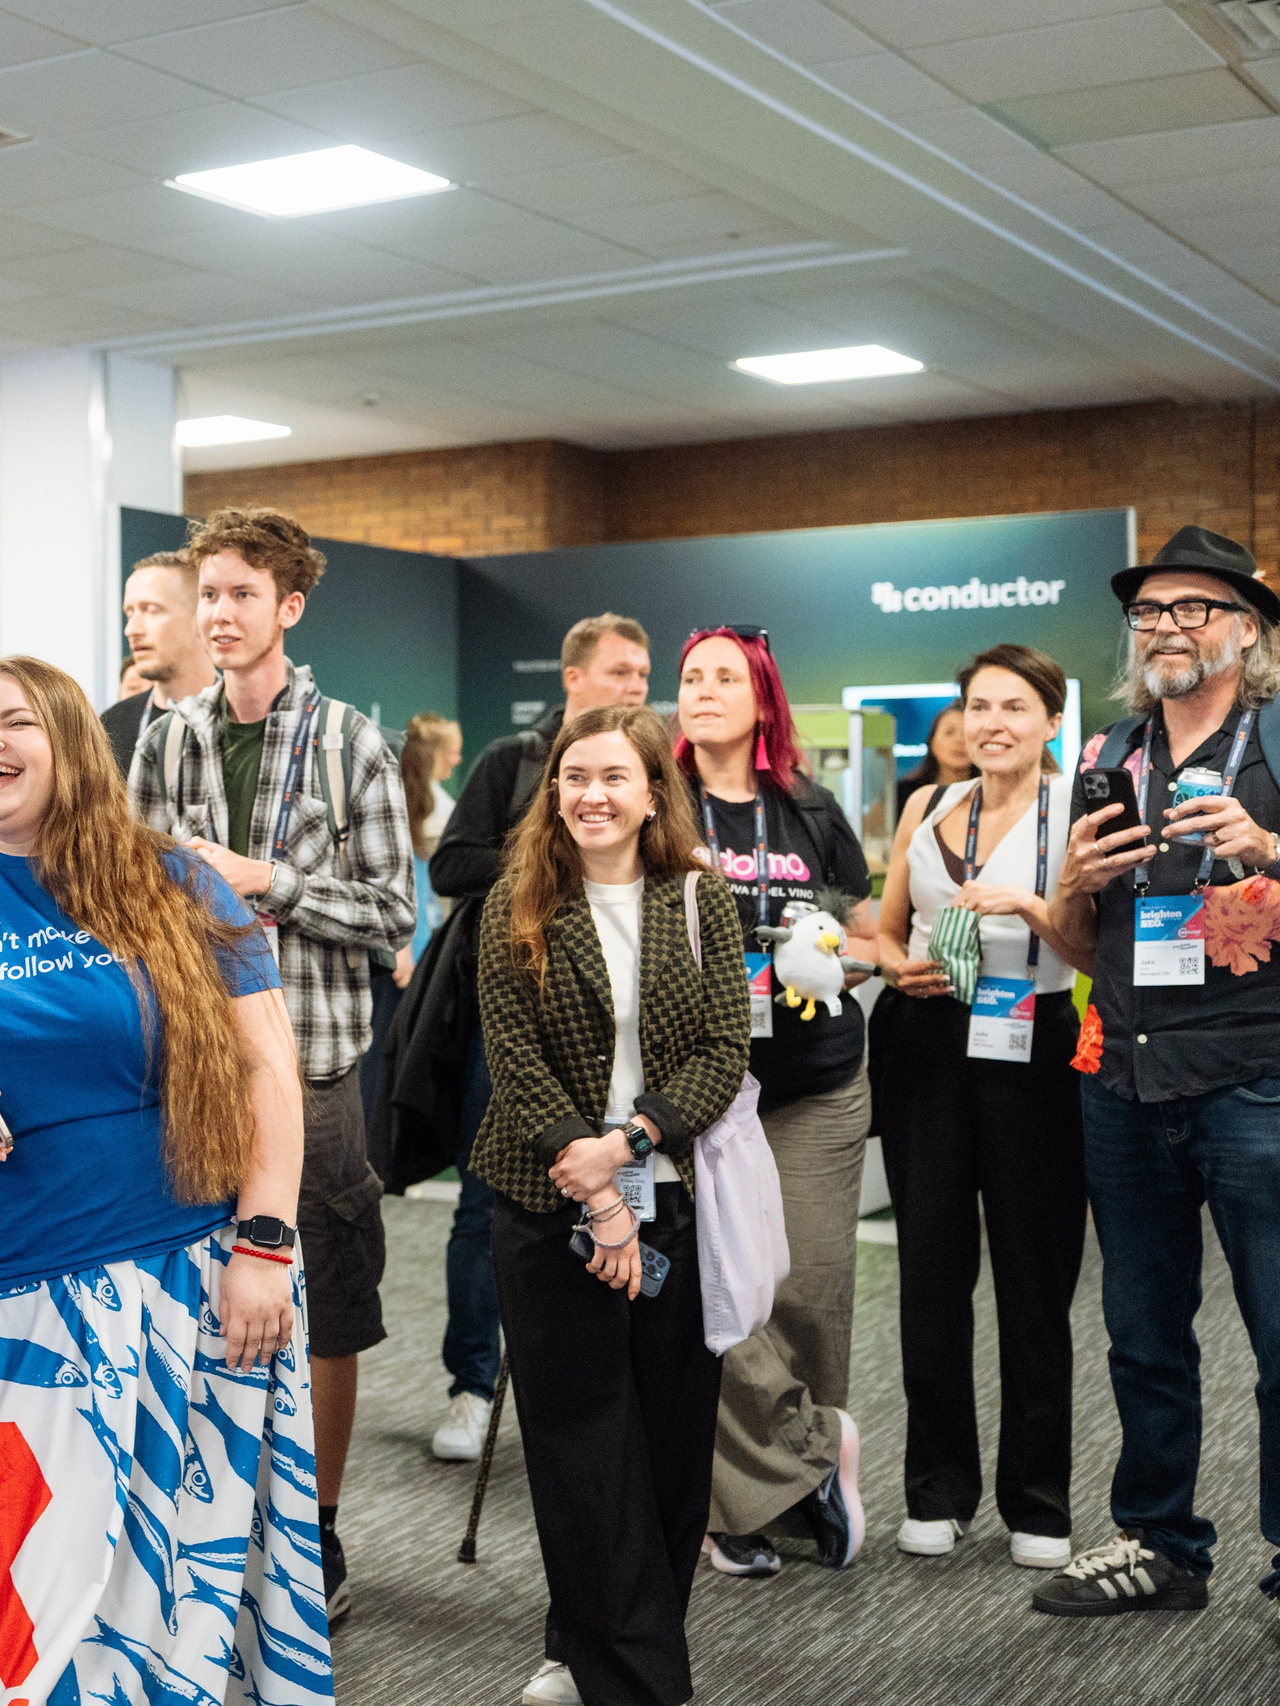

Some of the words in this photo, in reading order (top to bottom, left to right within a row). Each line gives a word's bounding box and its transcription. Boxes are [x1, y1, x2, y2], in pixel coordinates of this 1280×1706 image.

[903, 576, 1066, 612] conductor
[788, 886, 814, 899] VINO
[1140, 909, 1182, 920] brighton
[27, 926, 91, 948] make
